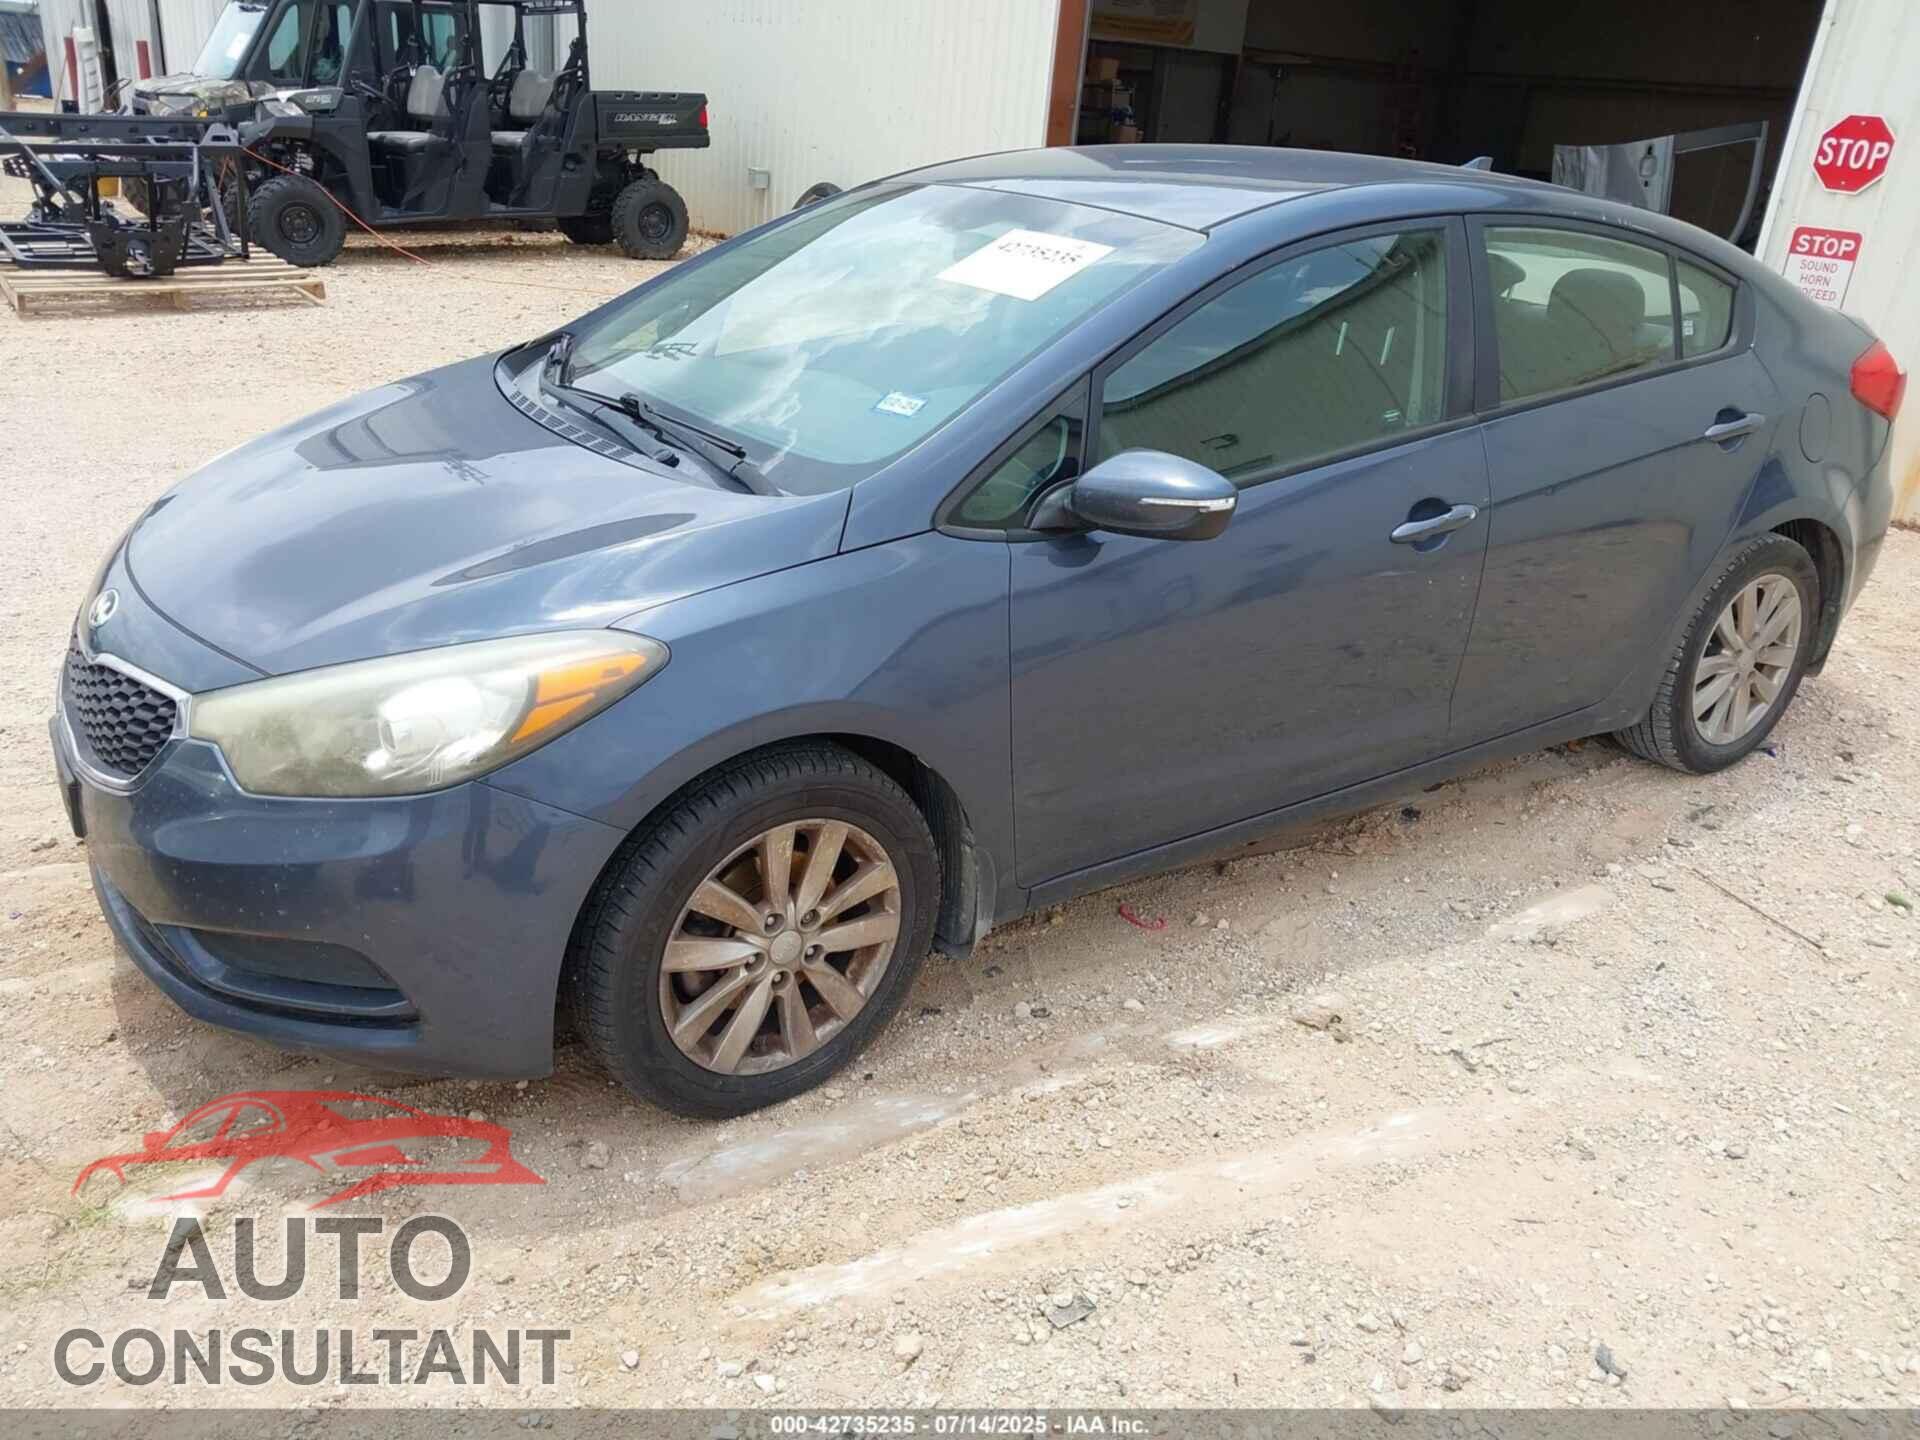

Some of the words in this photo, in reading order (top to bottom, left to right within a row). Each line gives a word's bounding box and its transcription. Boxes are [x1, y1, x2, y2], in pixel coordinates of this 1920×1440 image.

[1818, 137, 1889, 170] STOP
[1796, 234, 1856, 257] STOP
[1799, 259, 1838, 273] SOUND
[1799, 273, 1832, 287] HORN
